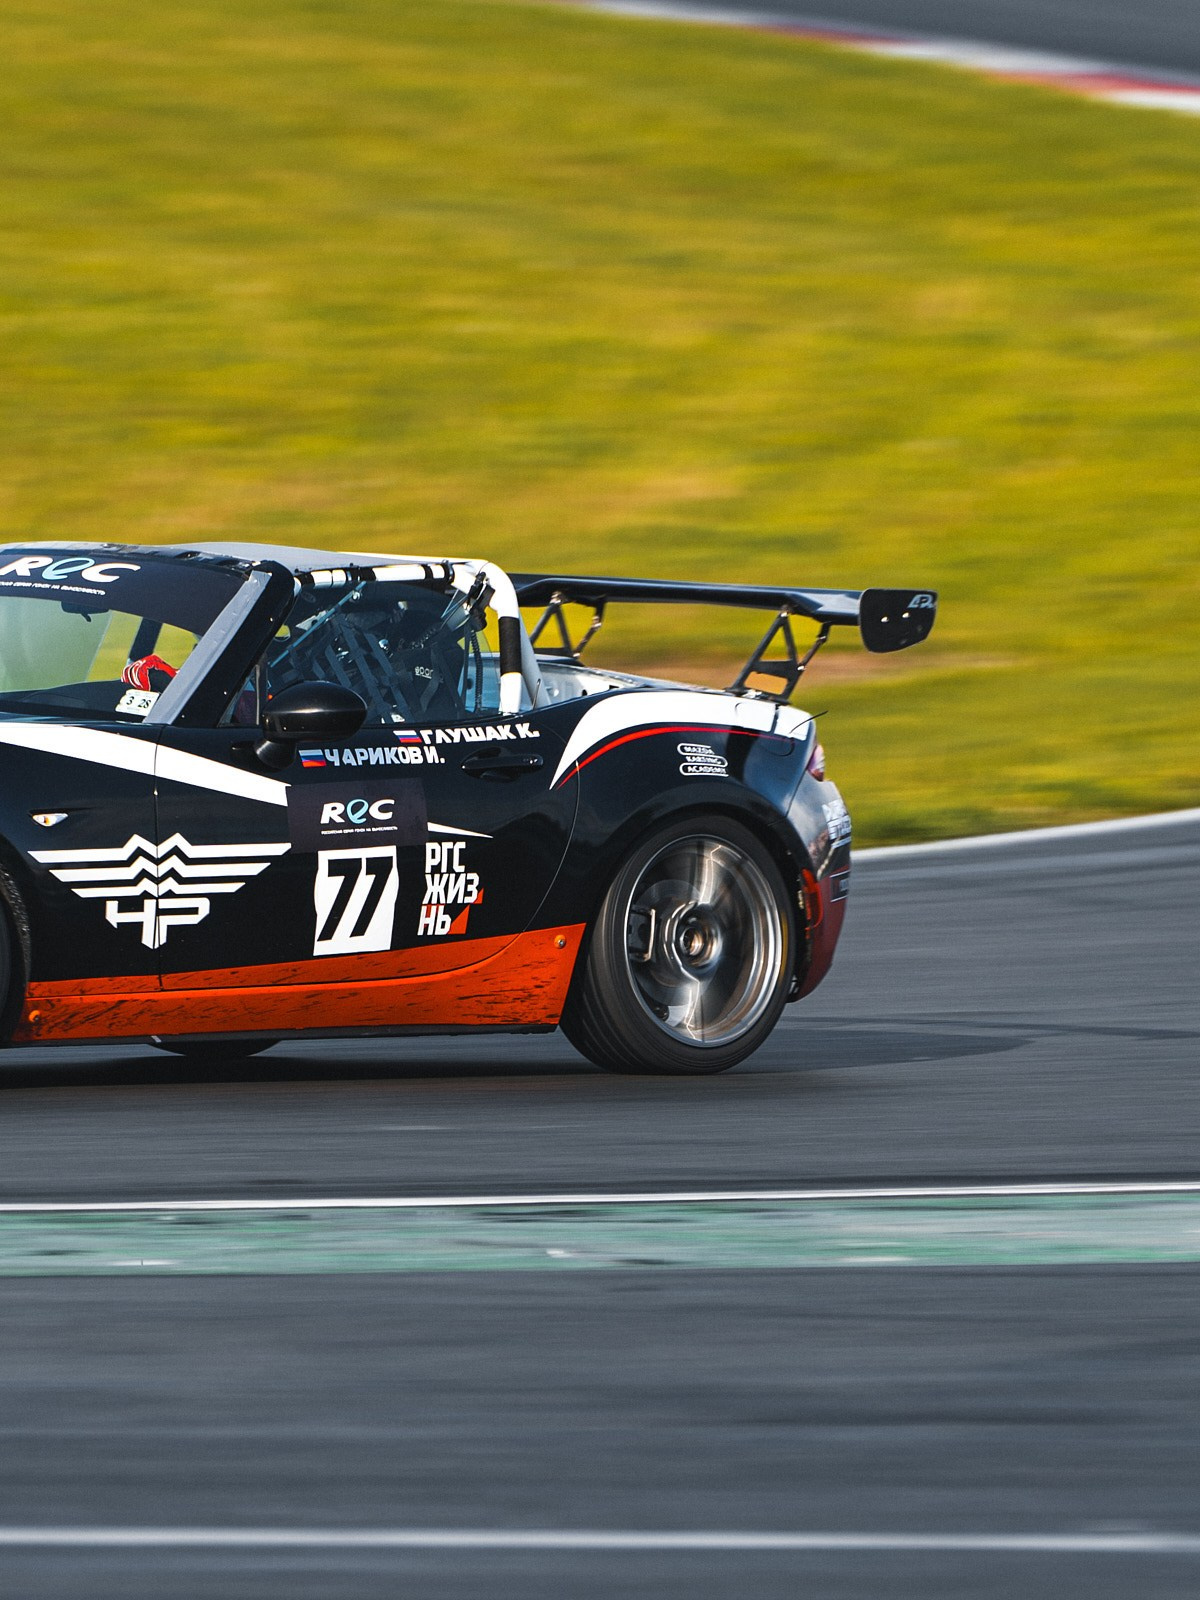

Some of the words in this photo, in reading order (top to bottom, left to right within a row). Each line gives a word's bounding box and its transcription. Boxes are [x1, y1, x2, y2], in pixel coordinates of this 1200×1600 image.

[126, 695, 135, 705] 3
[419, 724, 517, 745] ГЛУШАК
[515, 722, 540, 739] К.
[324, 746, 424, 767] ЧАРИКОВ
[423, 746, 446, 764] И.
[425, 841, 467, 874] РГС
[316, 855, 394, 942] 77
[422, 872, 480, 905] ЖИЗ
[416, 904, 453, 936] НЬ
